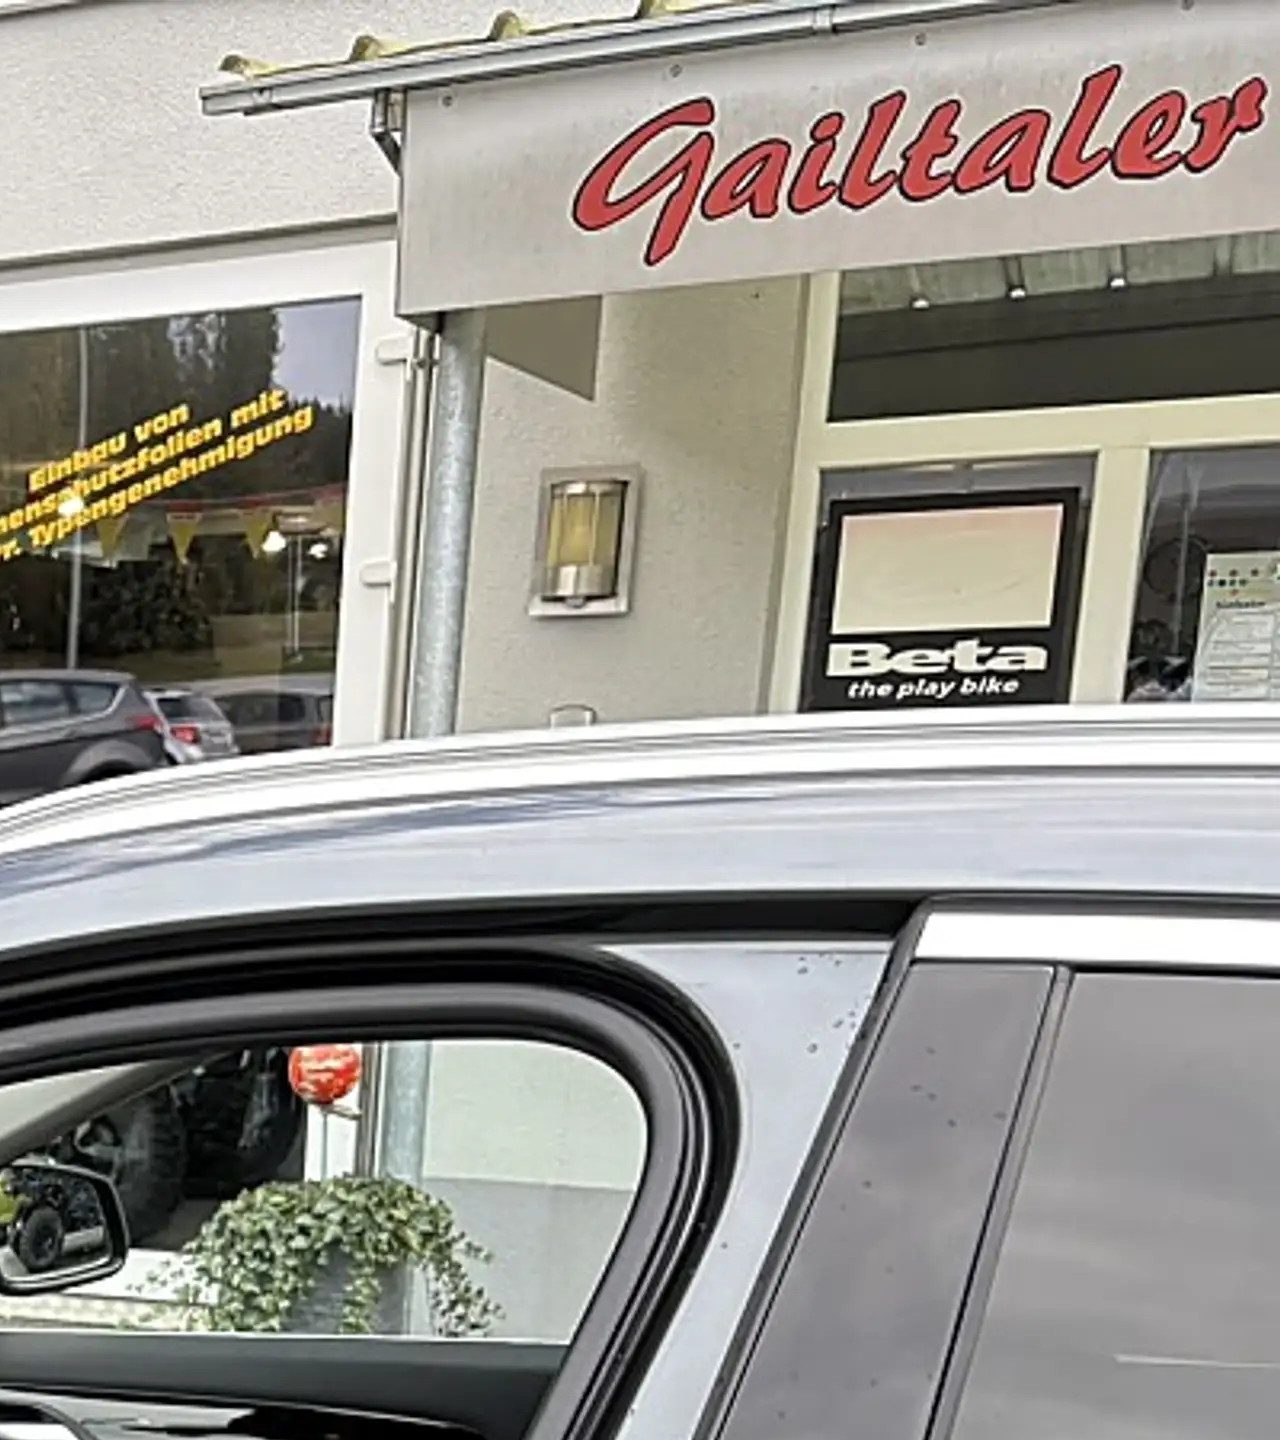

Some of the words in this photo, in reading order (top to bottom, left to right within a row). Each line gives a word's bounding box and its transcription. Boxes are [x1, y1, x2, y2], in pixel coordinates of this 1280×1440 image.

[572, 63, 1267, 266] Gailtaler
[230, 389, 288, 429] mit
[28, 432, 128, 493] Einbau
[134, 403, 192, 443] von
[825, 638, 1048, 677] Beta
[847, 680, 892, 699] the
[896, 679, 956, 699] play
[959, 676, 1020, 695] bike
